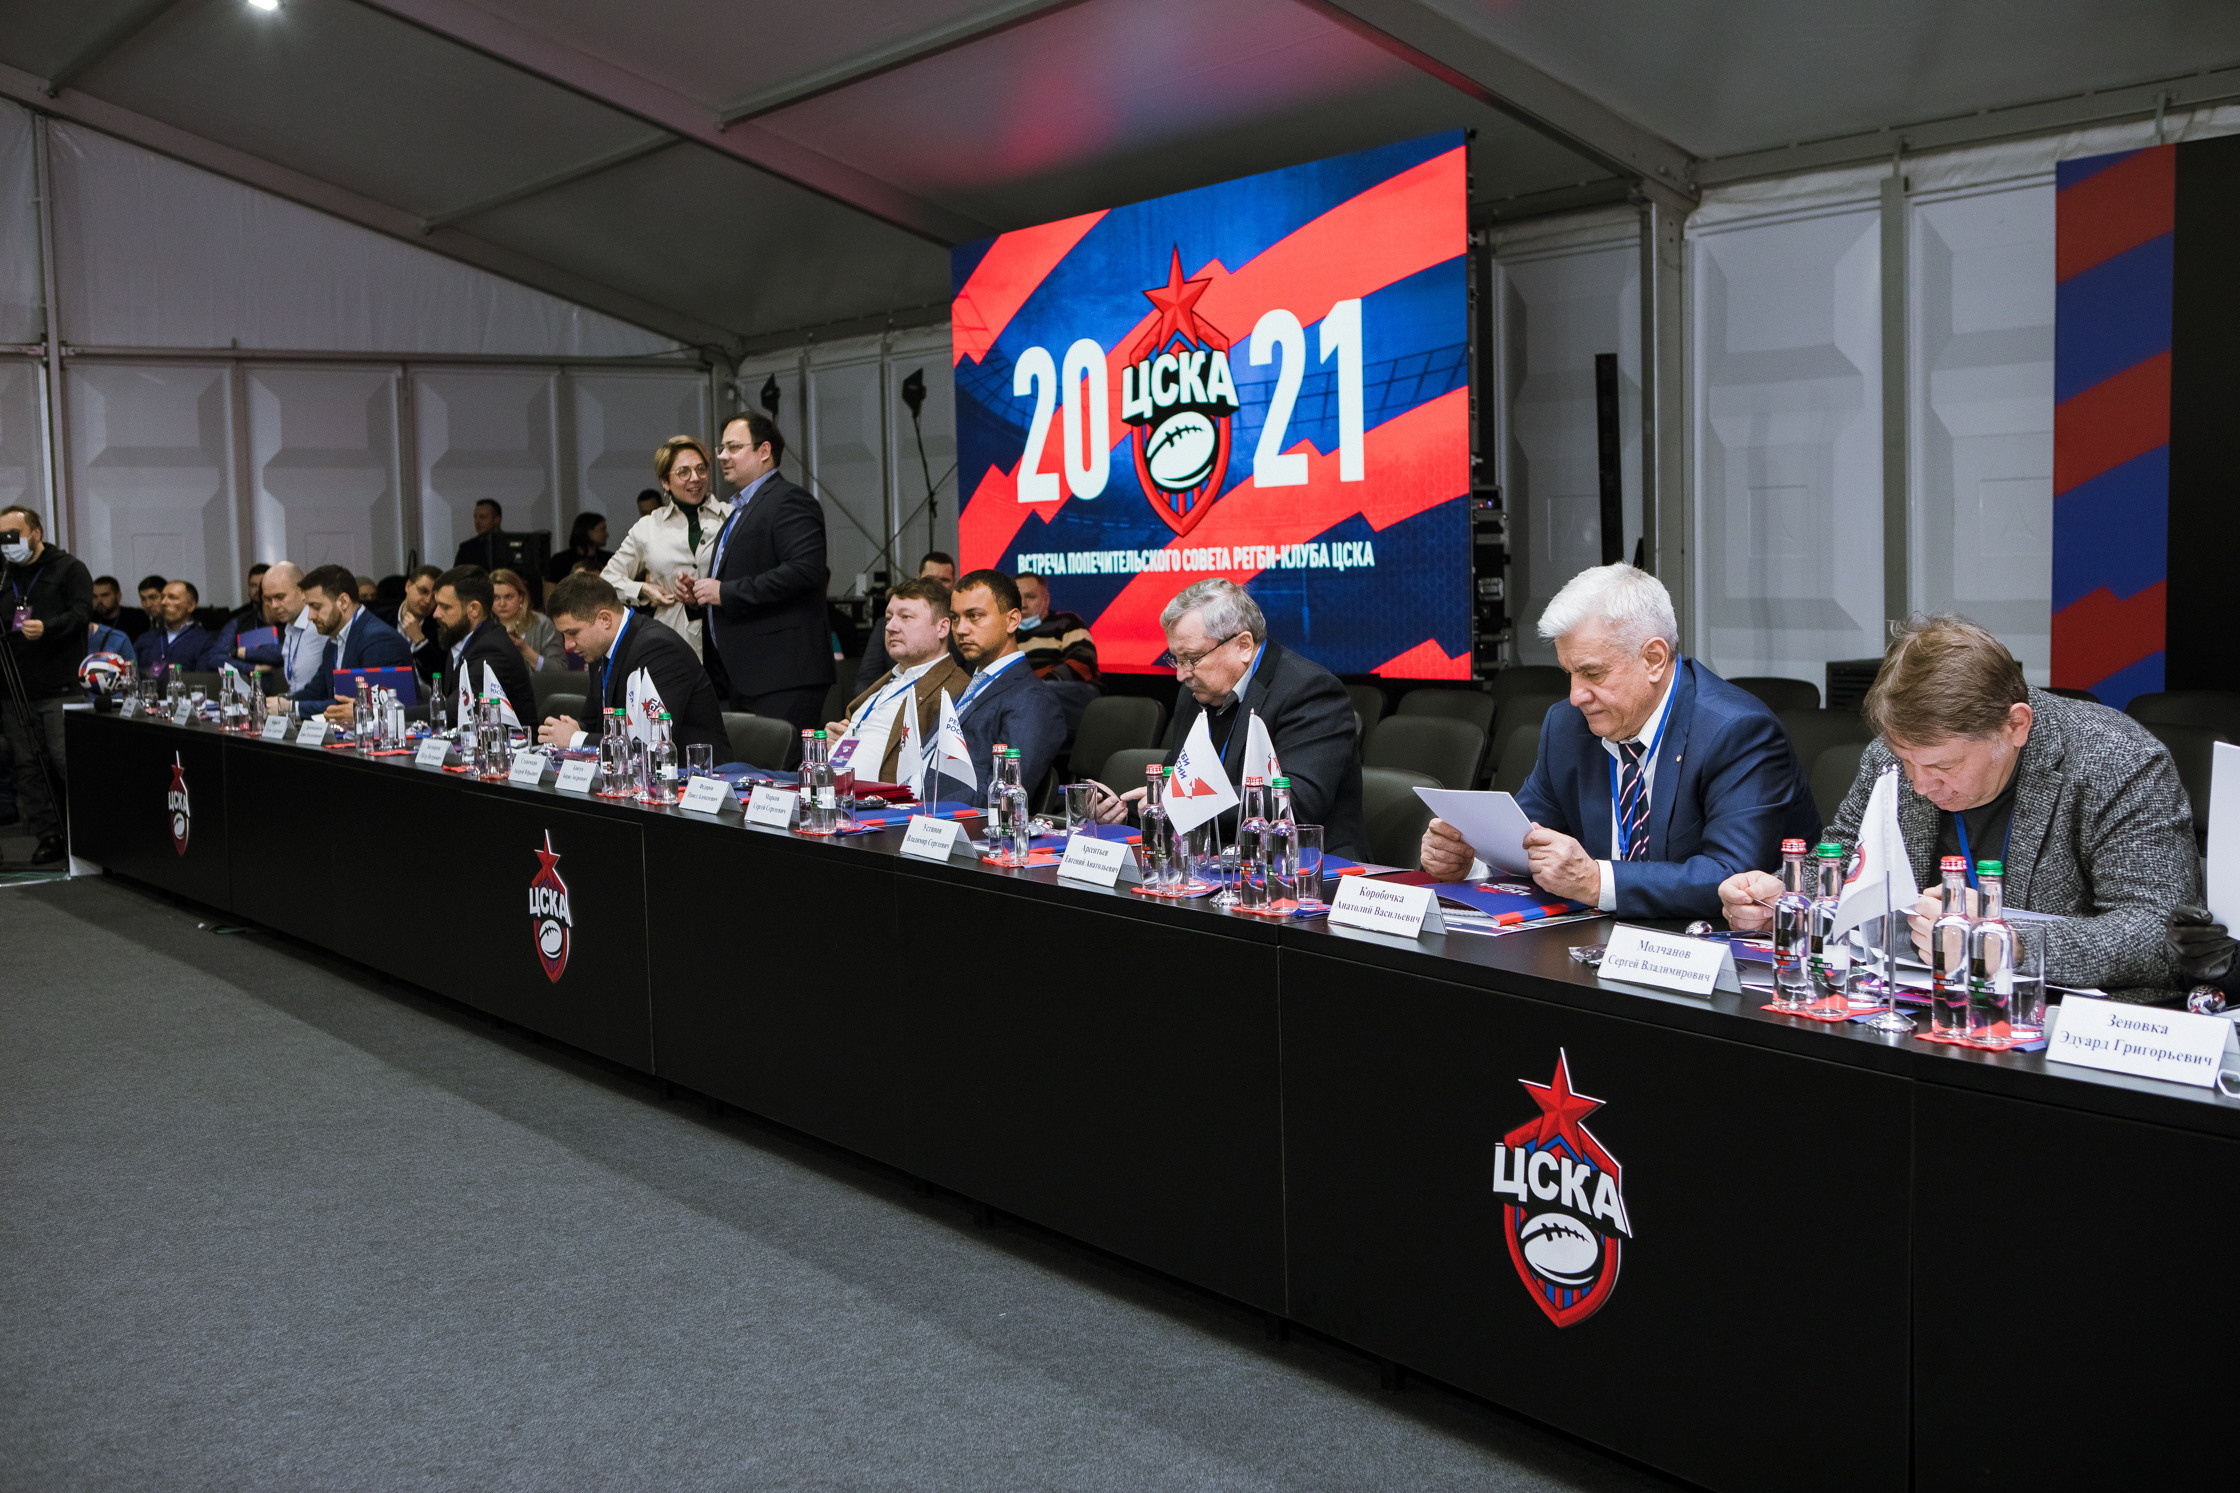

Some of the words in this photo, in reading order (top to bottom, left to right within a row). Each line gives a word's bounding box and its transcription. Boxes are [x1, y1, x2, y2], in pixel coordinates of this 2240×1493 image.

[1121, 349, 1241, 419] ЦСКА
[1249, 298, 1365, 488] 21
[1013, 338, 1111, 503] 20
[1017, 553, 1067, 575] ВСТРЕЧА
[1067, 549, 1181, 575] ПОПЕЧИТЕЛЬСКОГО
[1182, 547, 1232, 572] СОВЕТА
[1233, 543, 1330, 571] РЕГБИ-КЛУБА
[1332, 541, 1376, 571] ЦСКА
[1064, 854, 1085, 866] Евгений
[1085, 861, 1119, 874] Анатольевич
[1082, 844, 1109, 857] Арсентьев
[529, 887, 571, 926] ЦСКА
[1359, 886, 1405, 904] Коробочка
[1335, 900, 1373, 915] Анатолий
[1374, 906, 1421, 924] Васильевич
[1638, 940, 1692, 959] Молчанов
[1608, 954, 1640, 971] Сергей
[1640, 961, 1711, 982] Владимирович
[2107, 1013, 2169, 1036] Зеновка
[2058, 1030, 2110, 1051] Эдуард
[2112, 1038, 2212, 1067] Григорьевич
[1493, 1143, 1629, 1237] ЦСКА
